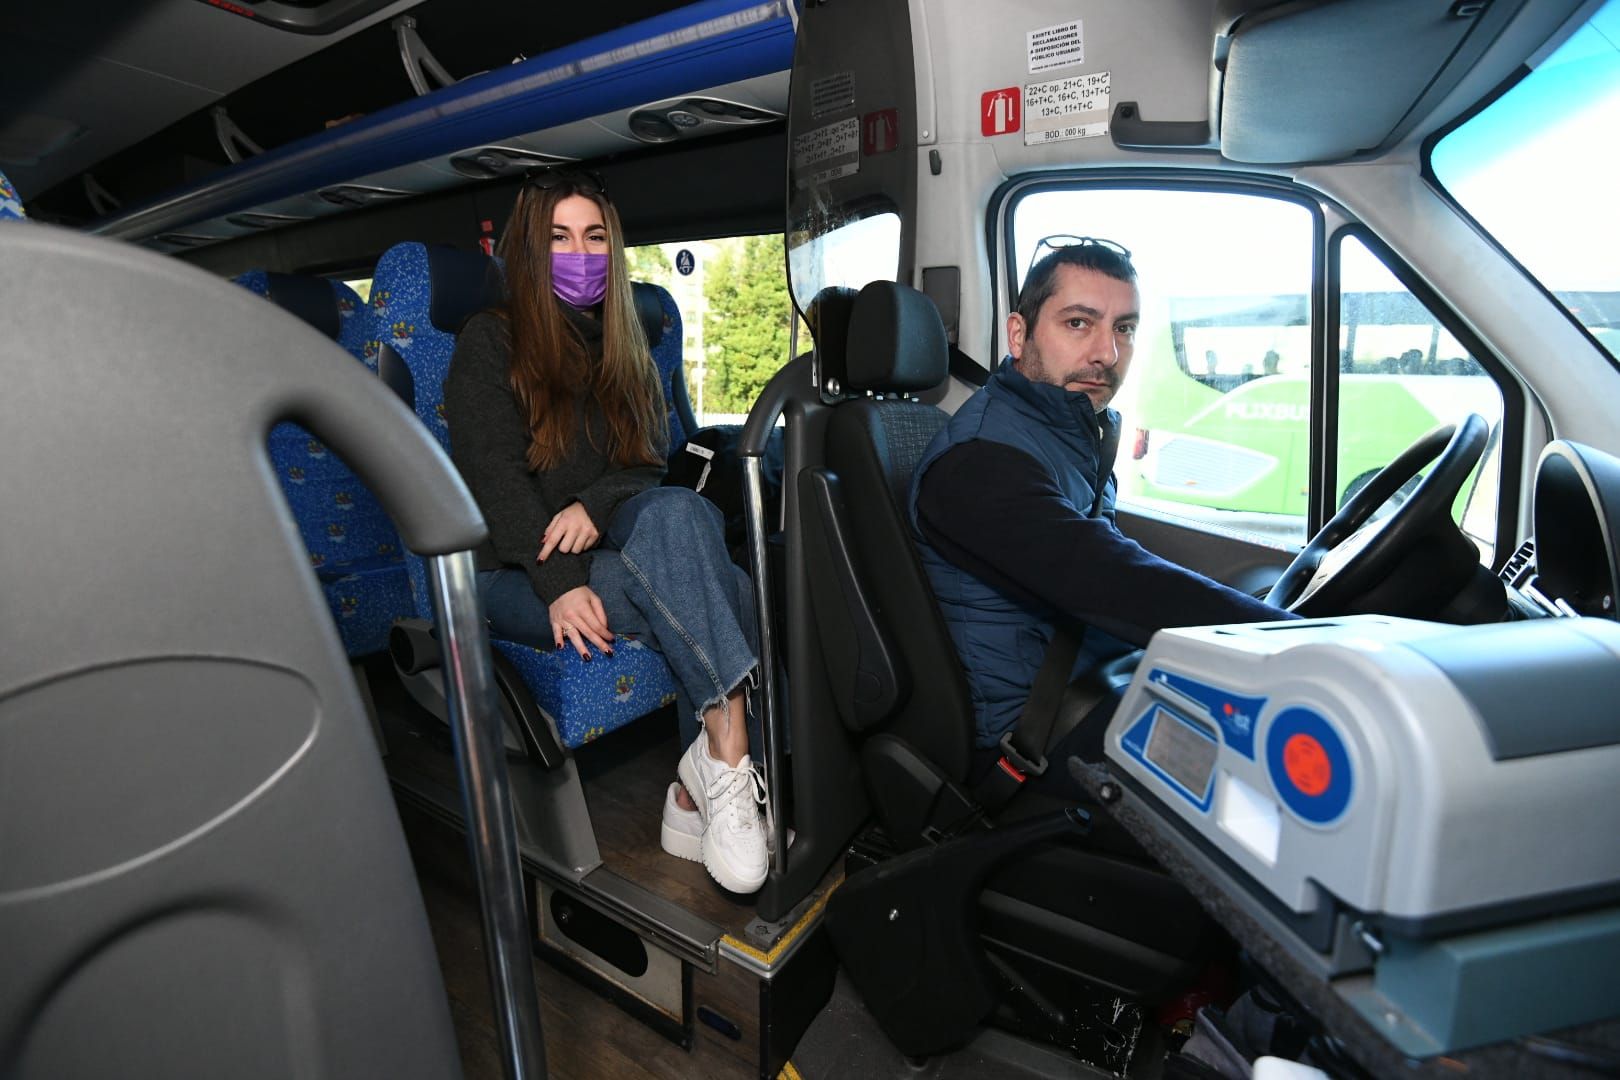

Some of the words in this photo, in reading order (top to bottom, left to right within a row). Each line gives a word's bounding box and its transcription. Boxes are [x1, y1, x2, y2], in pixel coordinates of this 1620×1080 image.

[1052, 26, 1069, 35] LIBRO
[1032, 32, 1078, 47] RECLAMACIONES
[1055, 46, 1081, 57] USUARIO
[1029, 84, 1047, 96] 22+C
[1063, 78, 1085, 90] 21+C,
[1088, 74, 1107, 87] 19+C
[1058, 91, 1079, 102] 16+C,
[1082, 85, 1111, 99] 13+T+C
[1041, 106, 1062, 117] 13+C,
[1064, 100, 1093, 113] 11+T+C
[1078, 127, 1086, 137] kg
